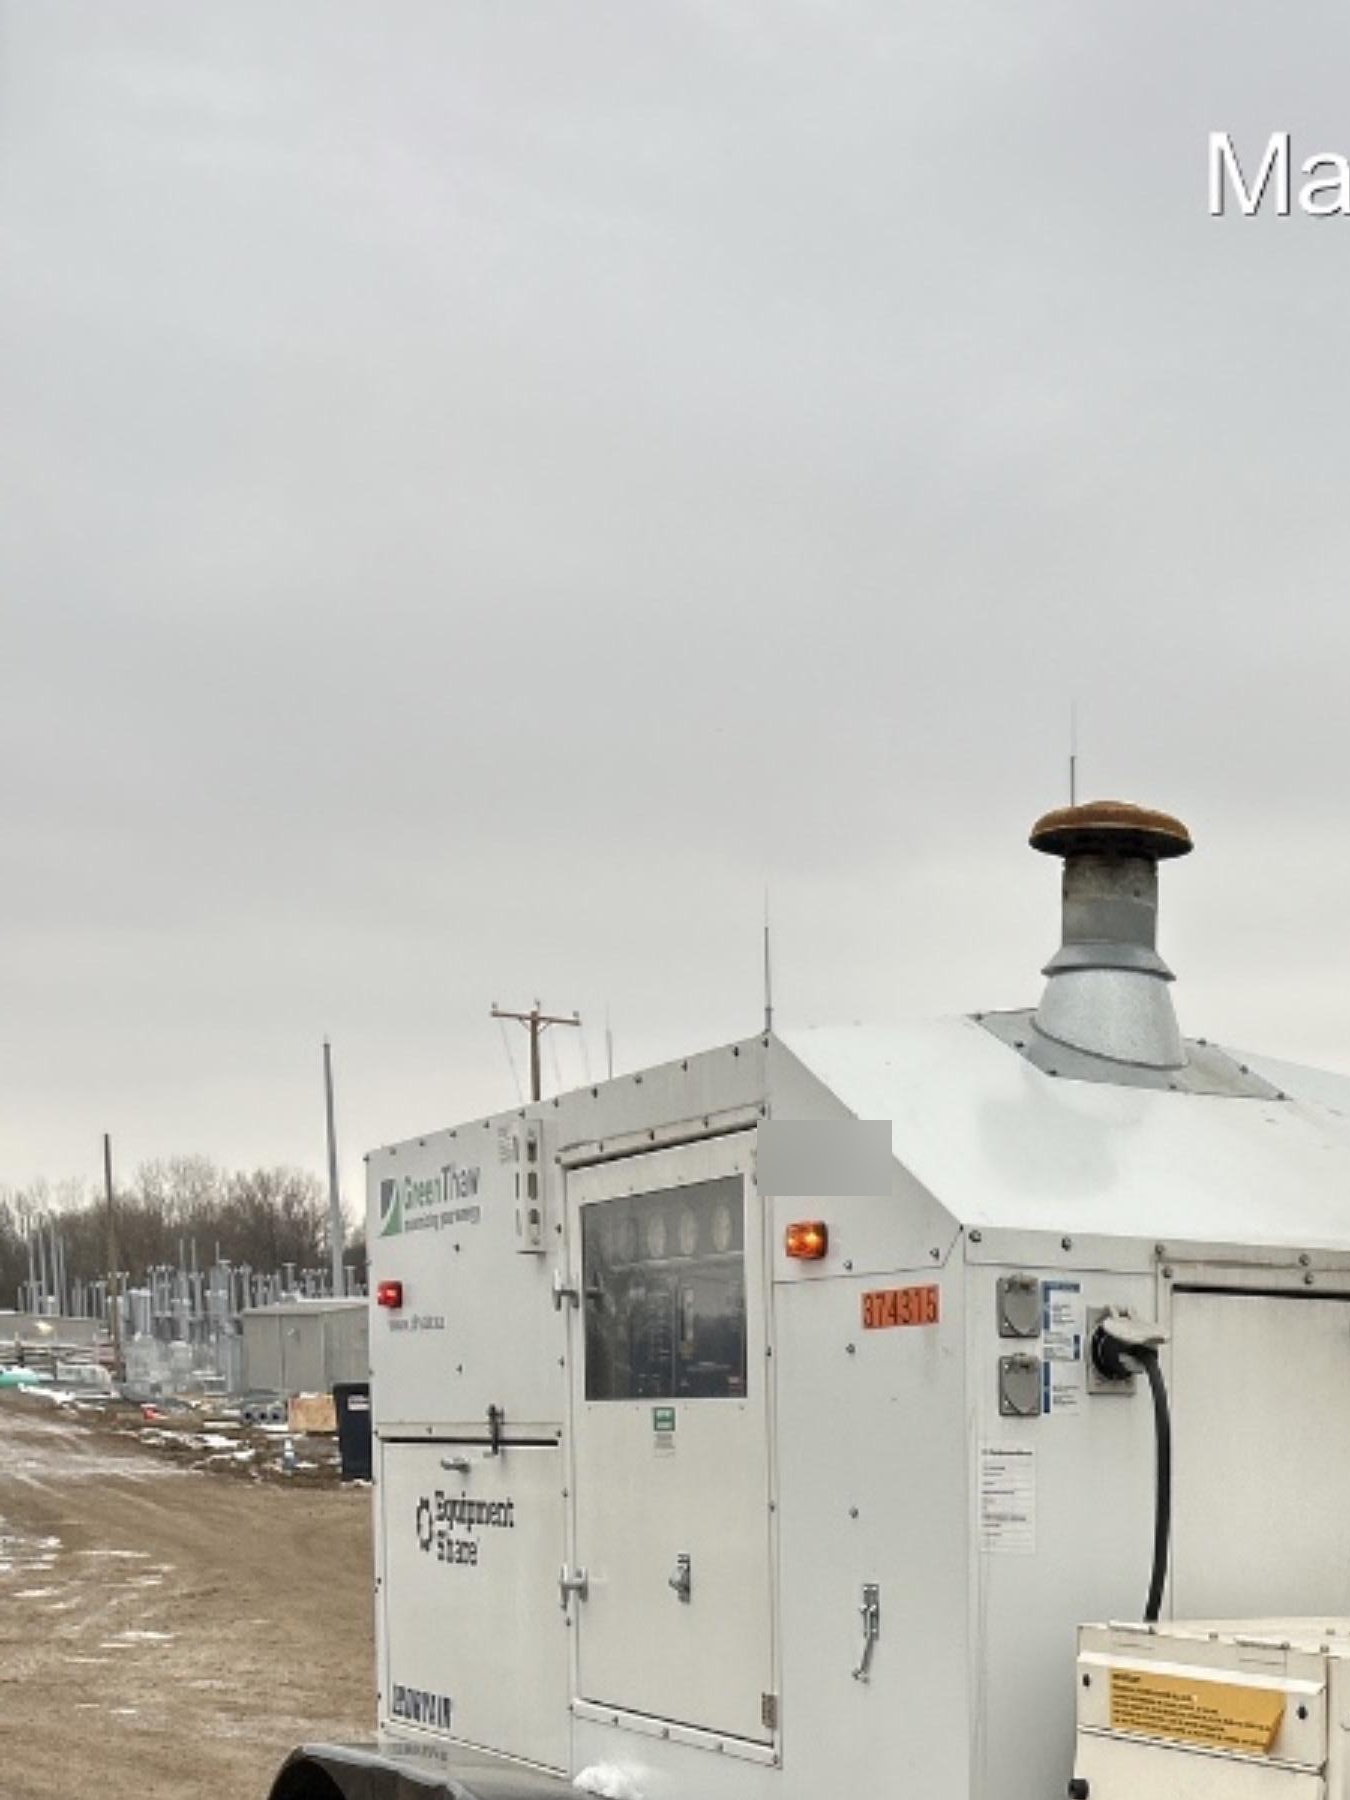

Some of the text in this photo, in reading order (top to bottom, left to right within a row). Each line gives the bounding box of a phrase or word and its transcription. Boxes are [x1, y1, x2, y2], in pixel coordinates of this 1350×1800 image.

[863, 1286, 938, 1327] 374315
[435, 1490, 514, 1533] Equipment
[437, 1529, 478, 1566] Share
